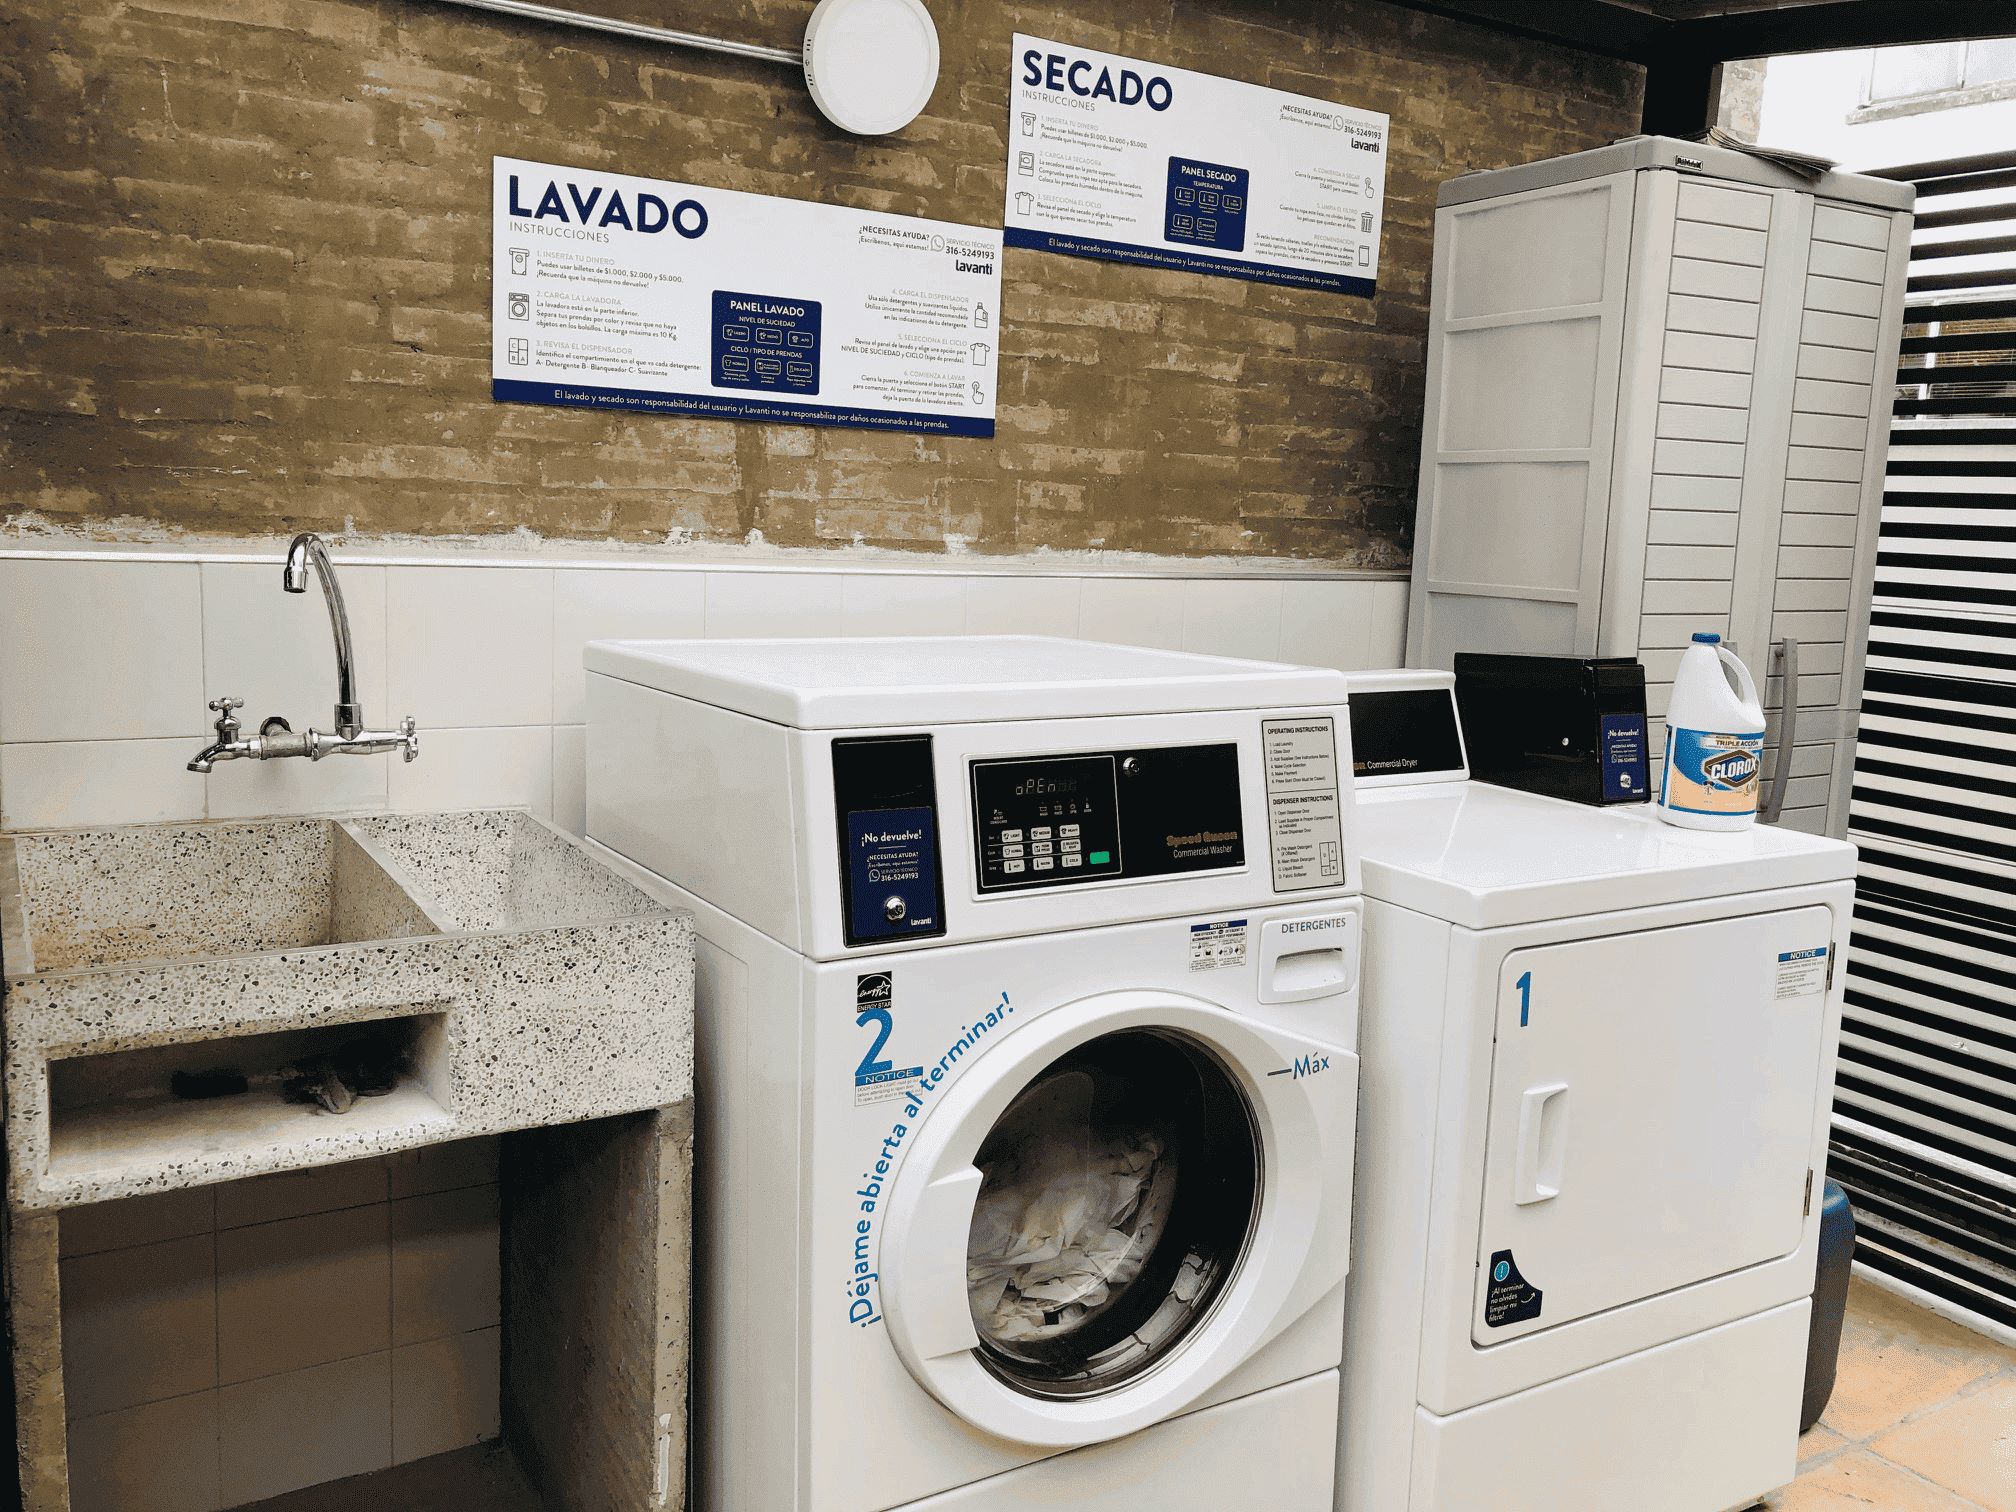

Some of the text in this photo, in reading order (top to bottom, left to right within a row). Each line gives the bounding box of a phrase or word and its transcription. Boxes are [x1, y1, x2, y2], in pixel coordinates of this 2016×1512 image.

[1023, 50, 1172, 112] SECADO
[1022, 90, 1096, 112] INSTRUCCIONES
[1280, 105, 1335, 120] ¿NECESITAS AYUDA?
[1344, 126, 1382, 140] 316-5249193
[1351, 138, 1380, 153] lavanti
[1182, 166, 1237, 182] PANEL SECADO
[1193, 180, 1224, 190] TEMPERATURA
[509, 175, 708, 239] LAVADO
[510, 222, 609, 243] INSTRUCCIONES
[859, 226, 930, 241] ¿NECESITAS AYUDA?
[858, 236, 893, 246] ¡Escríbenos,
[946, 238, 995, 250] SERVICIO TÉCNICO
[543, 251, 574, 260] INSERTA
[586, 256, 615, 266] DINERO
[946, 246, 995, 260] 316-5249193
[1056, 239, 1075, 249] lavado
[1112, 249, 1153, 260] responsabilidad
[1187, 258, 1206, 267] Lavanti
[1221, 265, 1255, 275] responsabiliza
[1266, 270, 1280, 278] daños
[1281, 273, 1310, 282] ocasionados
[537, 260, 558, 268] Puedes
[573, 264, 595, 273] billetes
[604, 267, 630, 277] $1.000,
[630, 270, 653, 279] $2.000
[659, 274, 683, 283] $5.000.
[956, 260, 992, 275] lavanti
[536, 271, 567, 279] ¡Recuerda
[587, 276, 612, 285] máquina
[622, 280, 649, 288] devuelve!
[544, 292, 570, 300] CARGA
[582, 295, 622, 306] LAVADORA
[545, 301, 570, 310] lavadora
[616, 308, 639, 316] inferior.
[730, 300, 805, 317] PANEL LAVADO
[766, 319, 796, 327] SUCIEDAD
[544, 341, 570, 349] REVISA
[581, 344, 633, 355] DISPENSADOR
[776, 350, 802, 358] PRENDAS
[545, 360, 580, 370] Detergente
[590, 363, 627, 373] Blanqueador
[638, 367, 668, 376] Suavizante
[565, 391, 590, 401] lavado
[598, 394, 625, 404] secado
[642, 399, 698, 409] responsabilidad
[699, 401, 710, 410] del
[712, 404, 737, 412] usuario
[745, 405, 770, 415] Lavanti
[791, 411, 836, 420] responsabiliza
[838, 415, 848, 423] por
[850, 413, 869, 422] daños
[870, 416, 908, 426] ocasionados
[914, 418, 922, 427] las
[924, 420, 949, 430] prendas.
[1367, 760, 1401, 769] Commercial
[1402, 759, 1418, 768] Dryer
[1710, 757, 1757, 779] CLOROX
[1273, 797, 1299, 805] DISPENSER
[862, 829, 922, 847] ¡No devuelve!
[1167, 831, 1237, 847] Speed Queen
[867, 854, 898, 862] ¿NECESITAS
[1173, 845, 1232, 859] Commercial Washer
[881, 872, 919, 881] 316-5249193
[911, 918, 932, 926] lavanti
[1282, 918, 1346, 934] DETERGENTES
[1790, 950, 1817, 959] NOTICE
[1516, 971, 1531, 1027] 1
[855, 1008, 893, 1076] 2
[920, 991, 1014, 1091] terminar!
[1293, 1052, 1330, 1079] Máx
[865, 1070, 914, 1083] NOTICE
[904, 1091, 923, 1118] al
[857, 1124, 907, 1213] abierta
[847, 1219, 882, 1327] ¡Déjame
[1501, 1283, 1525, 1294] terminar
[1499, 1293, 1518, 1303] olvides
[1489, 1304, 1508, 1313] limpiar
